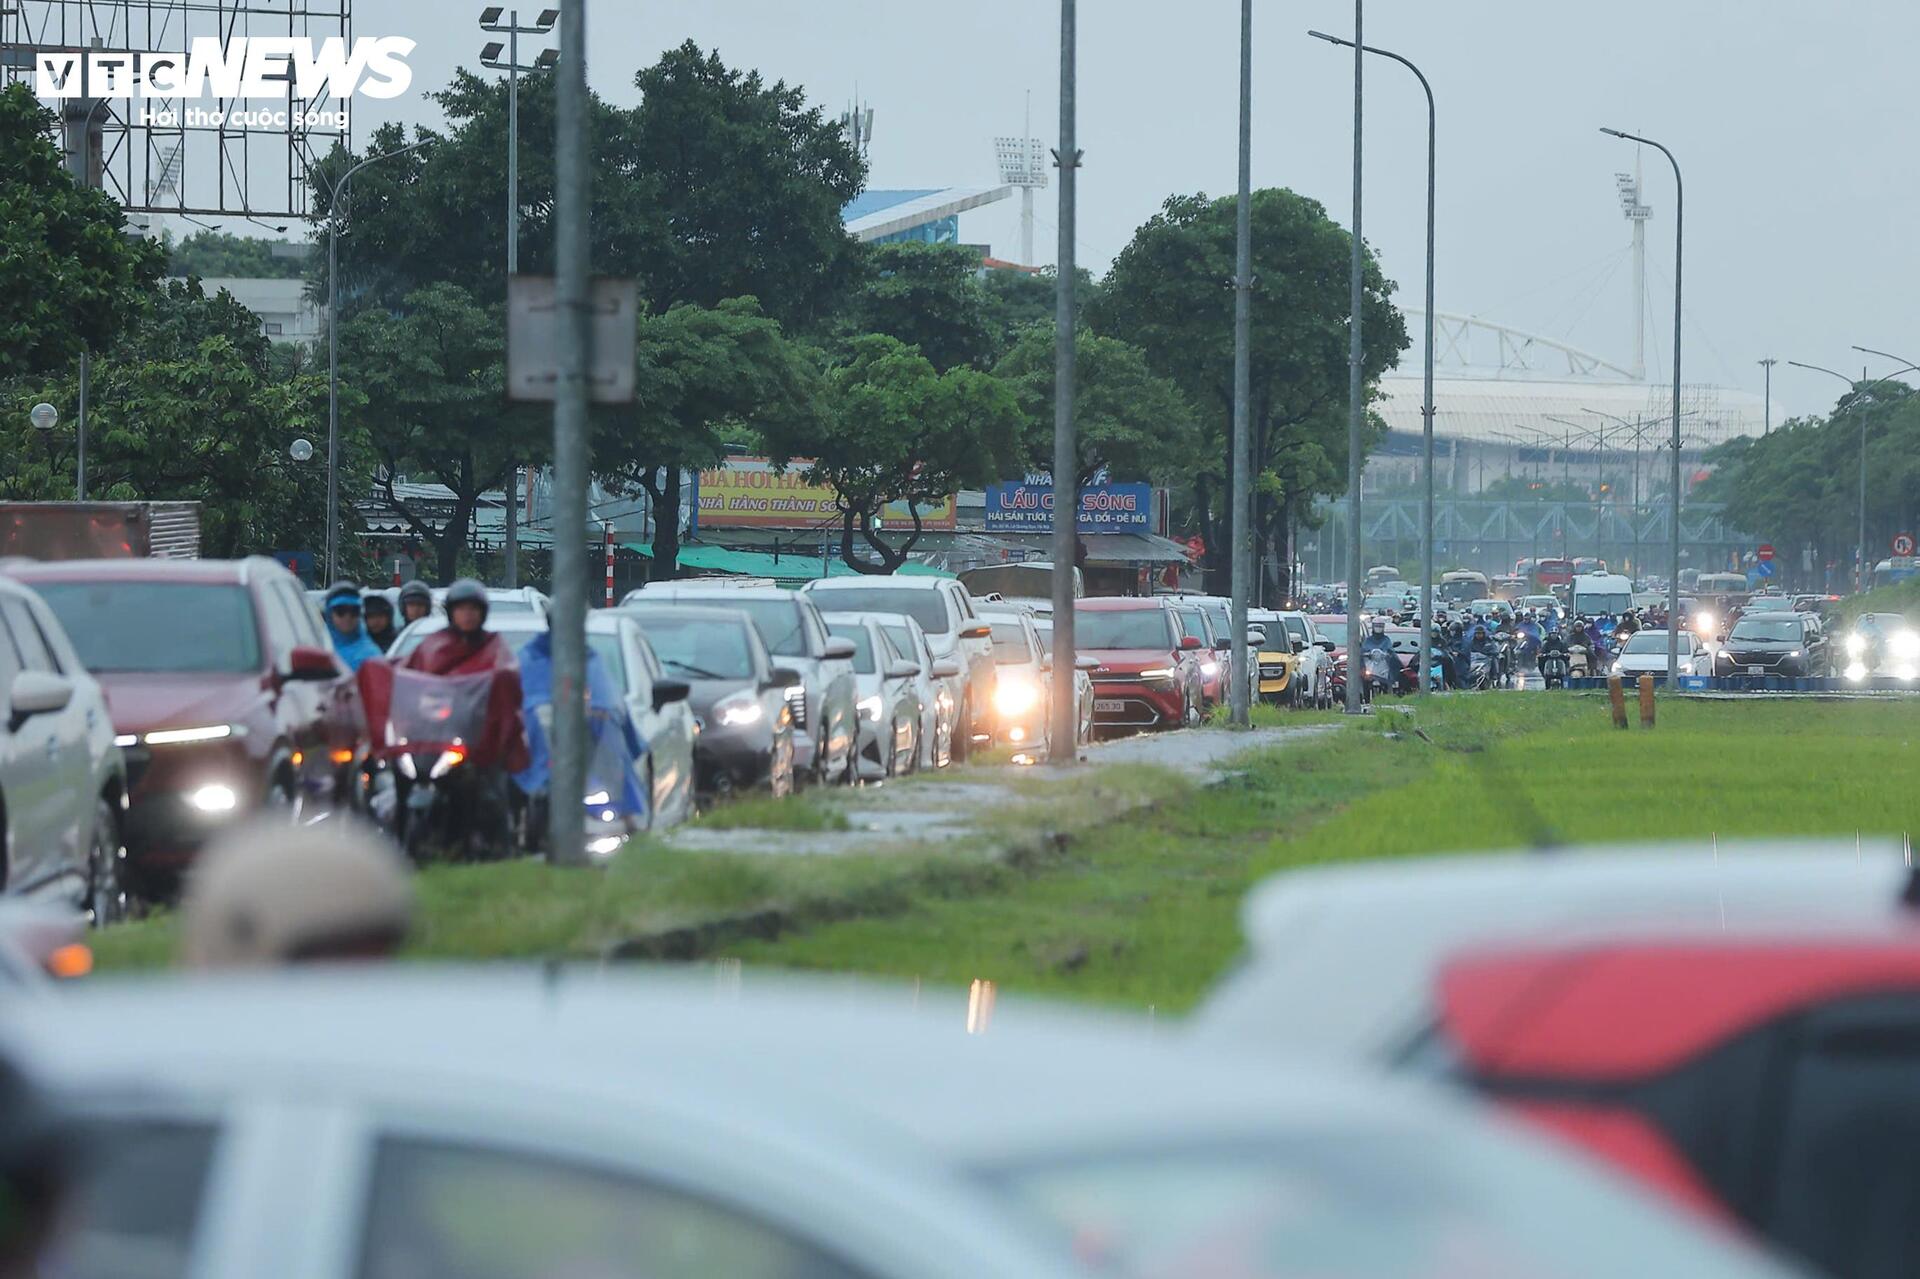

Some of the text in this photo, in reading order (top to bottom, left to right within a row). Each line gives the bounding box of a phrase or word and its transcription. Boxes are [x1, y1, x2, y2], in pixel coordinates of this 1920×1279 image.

[698, 493, 724, 509] NHÀ
[729, 494, 768, 511] HÀNG
[771, 495, 816, 512] THÀNH
[1082, 490, 1136, 511] SÔNG
